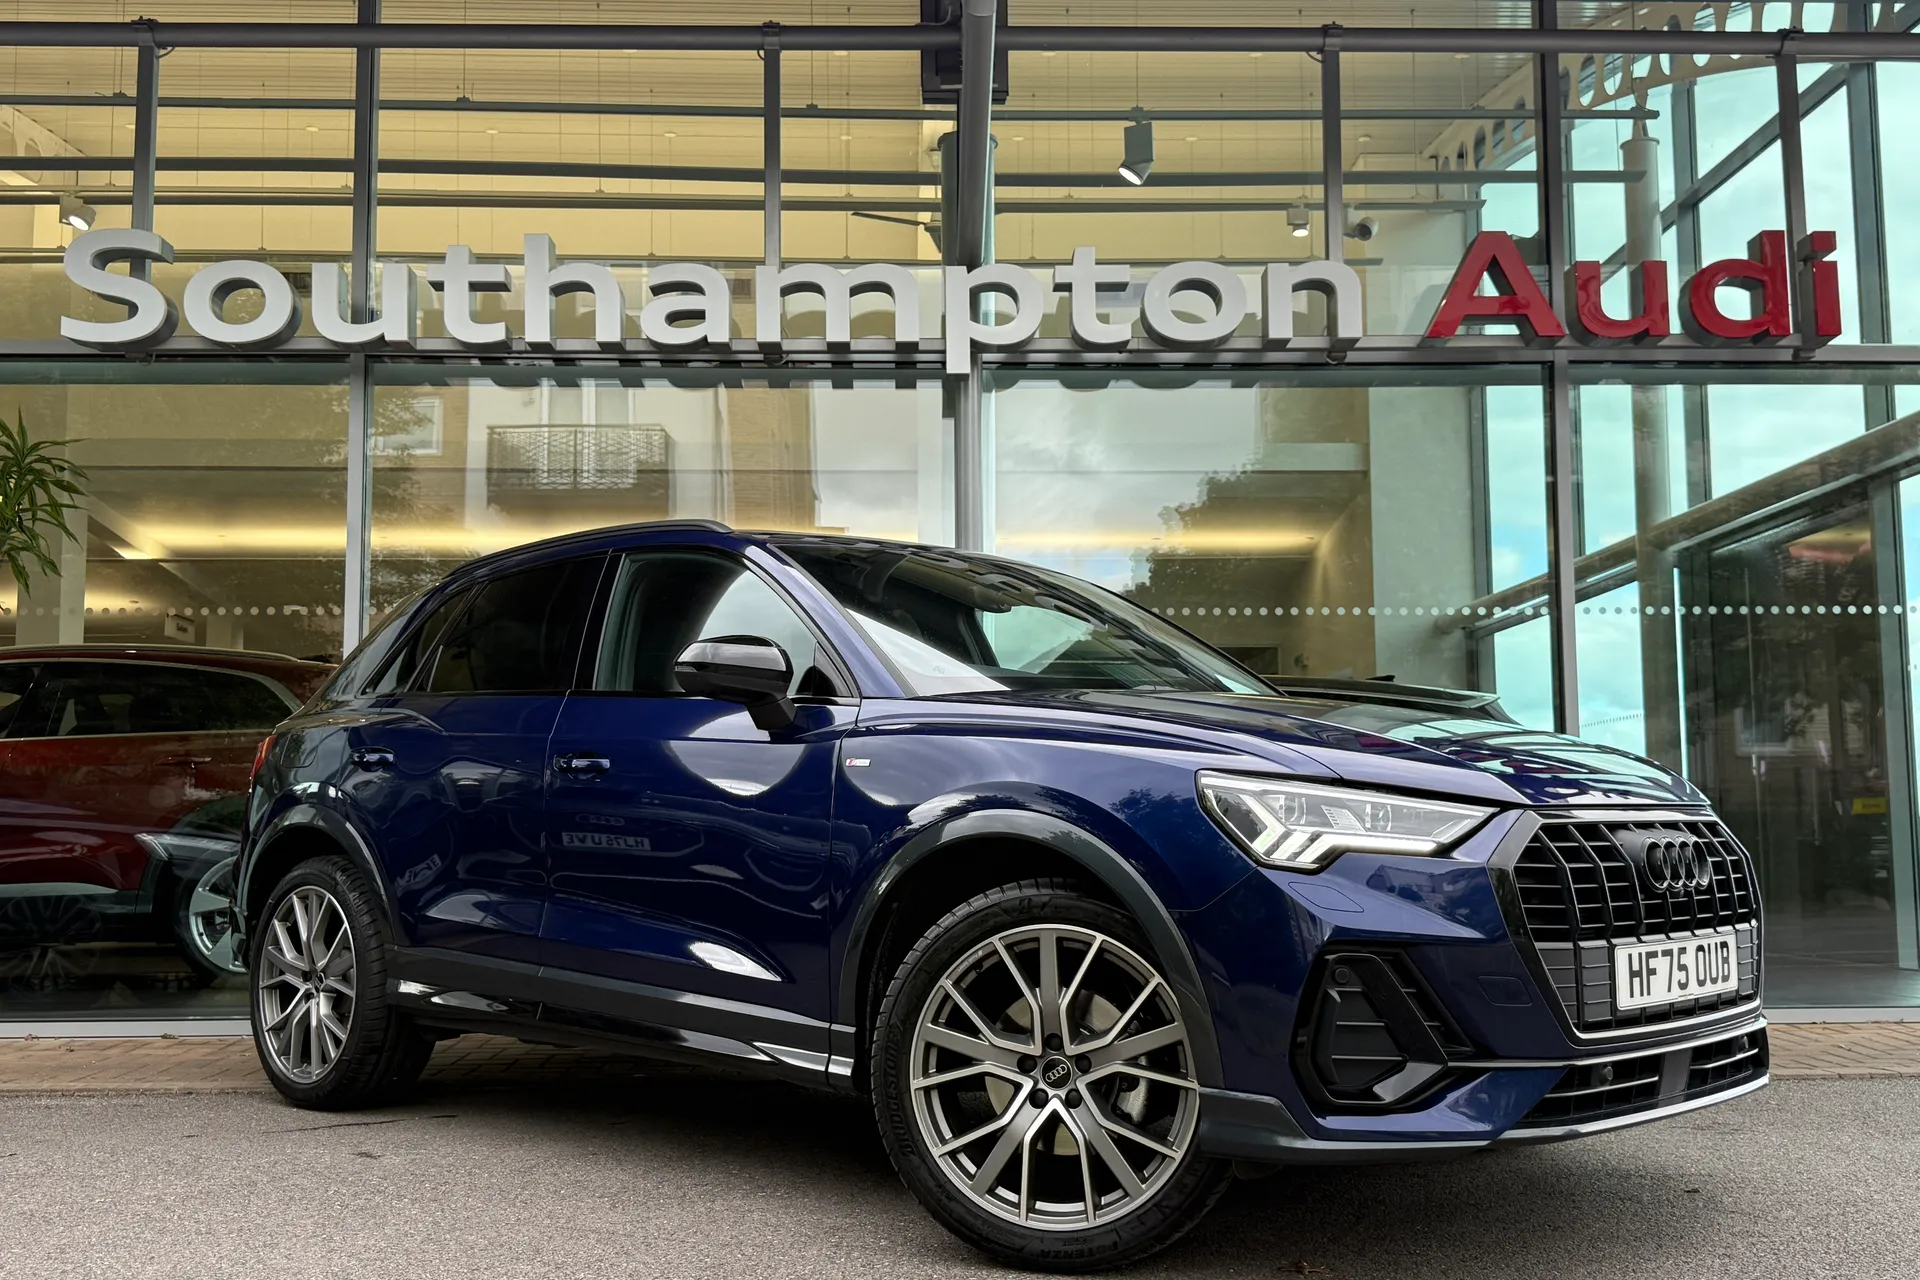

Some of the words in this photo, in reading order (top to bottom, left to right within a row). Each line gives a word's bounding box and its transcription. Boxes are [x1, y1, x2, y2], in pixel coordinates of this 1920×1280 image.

[60, 228, 1362, 373] Southampton
[1421, 230, 1841, 344] Audi
[1628, 947, 1689, 998] HF75
[1696, 941, 1731, 987] OUB
